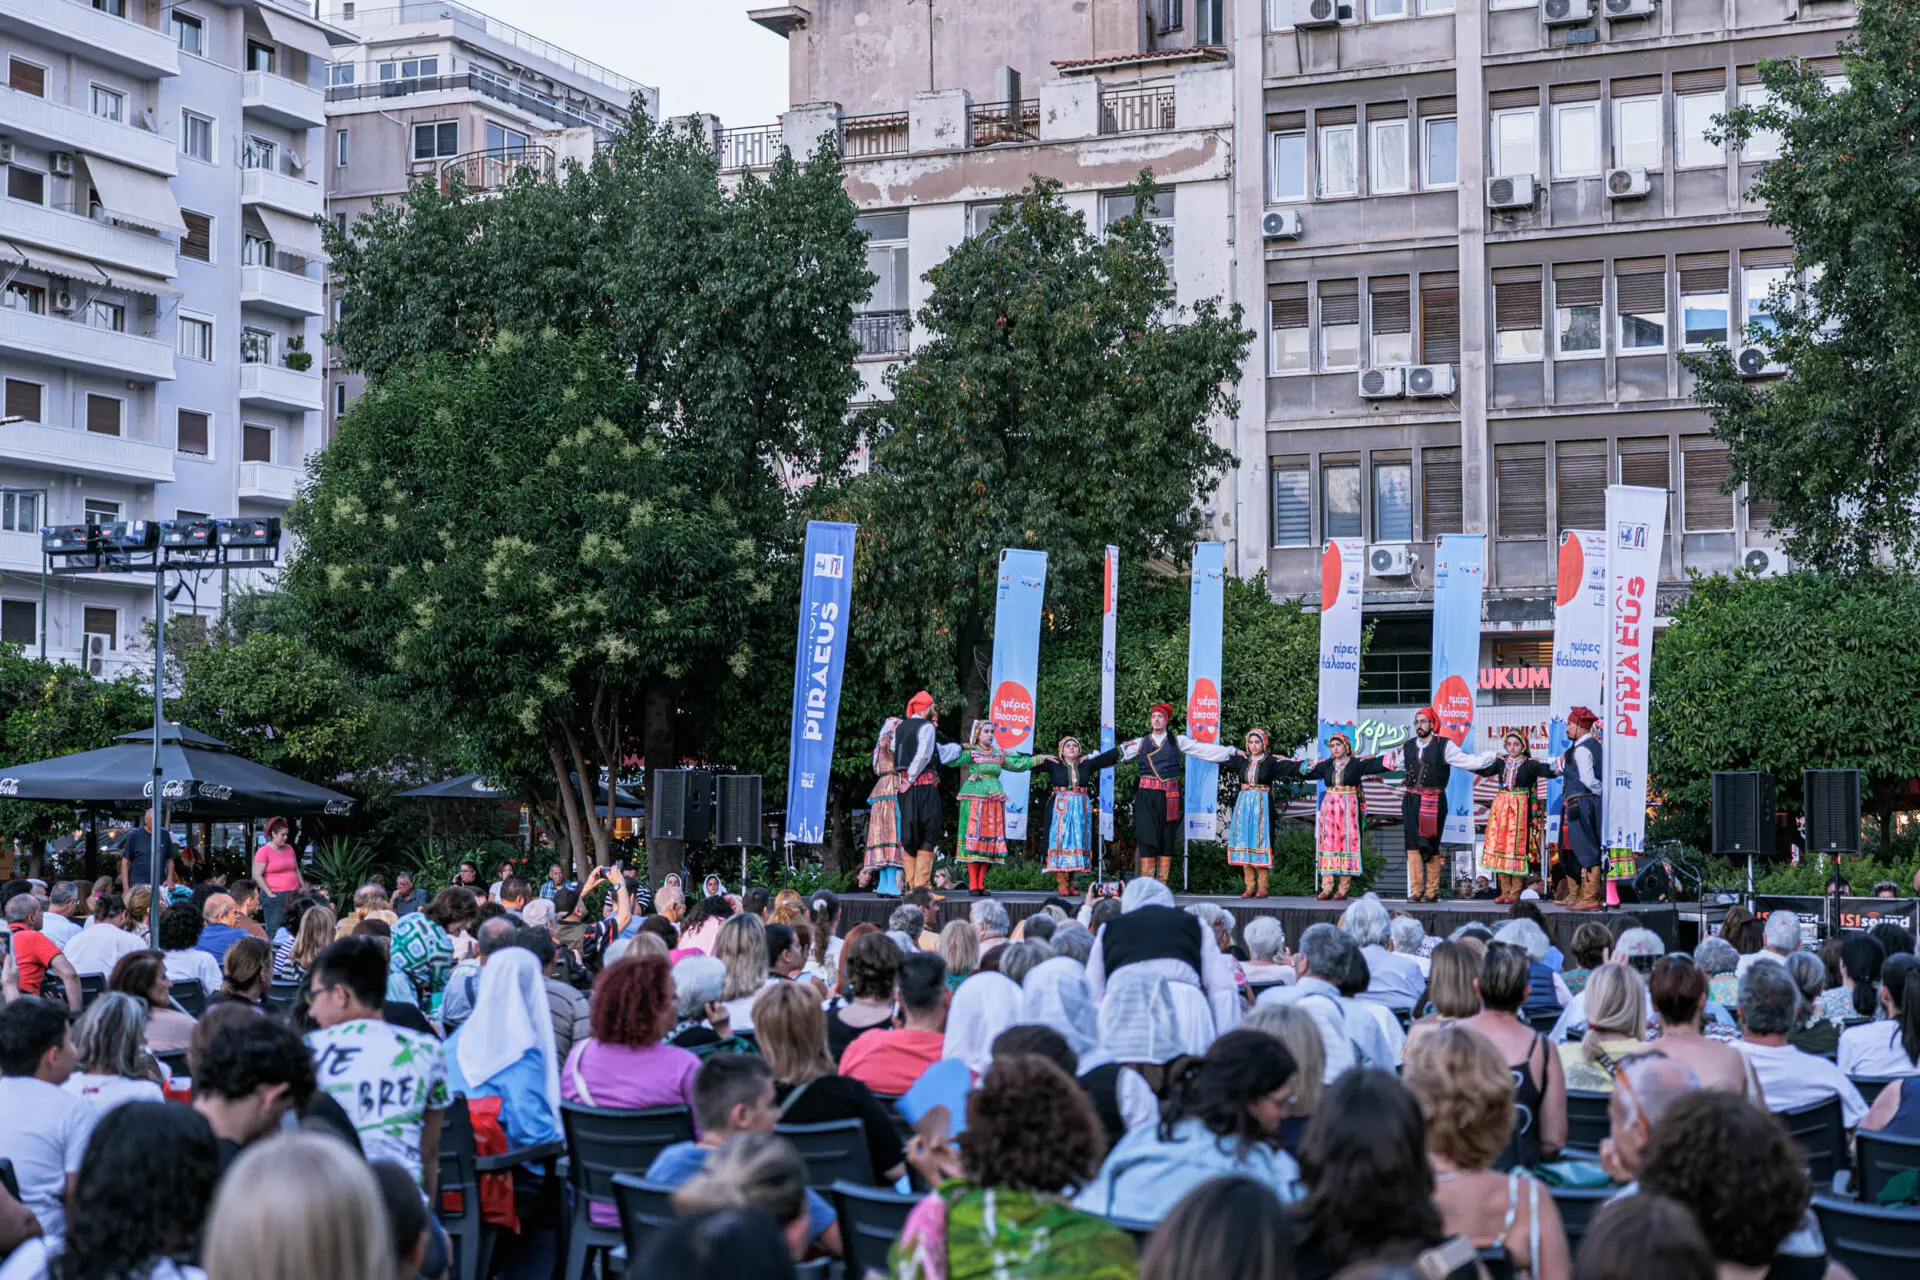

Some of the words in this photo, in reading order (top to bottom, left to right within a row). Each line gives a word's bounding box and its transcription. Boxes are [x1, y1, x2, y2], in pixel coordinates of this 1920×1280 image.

[804, 601, 839, 741] PIRAEUS
[1477, 667, 1552, 690] UKUM
[1622, 576, 1646, 737] PIRAEUS
